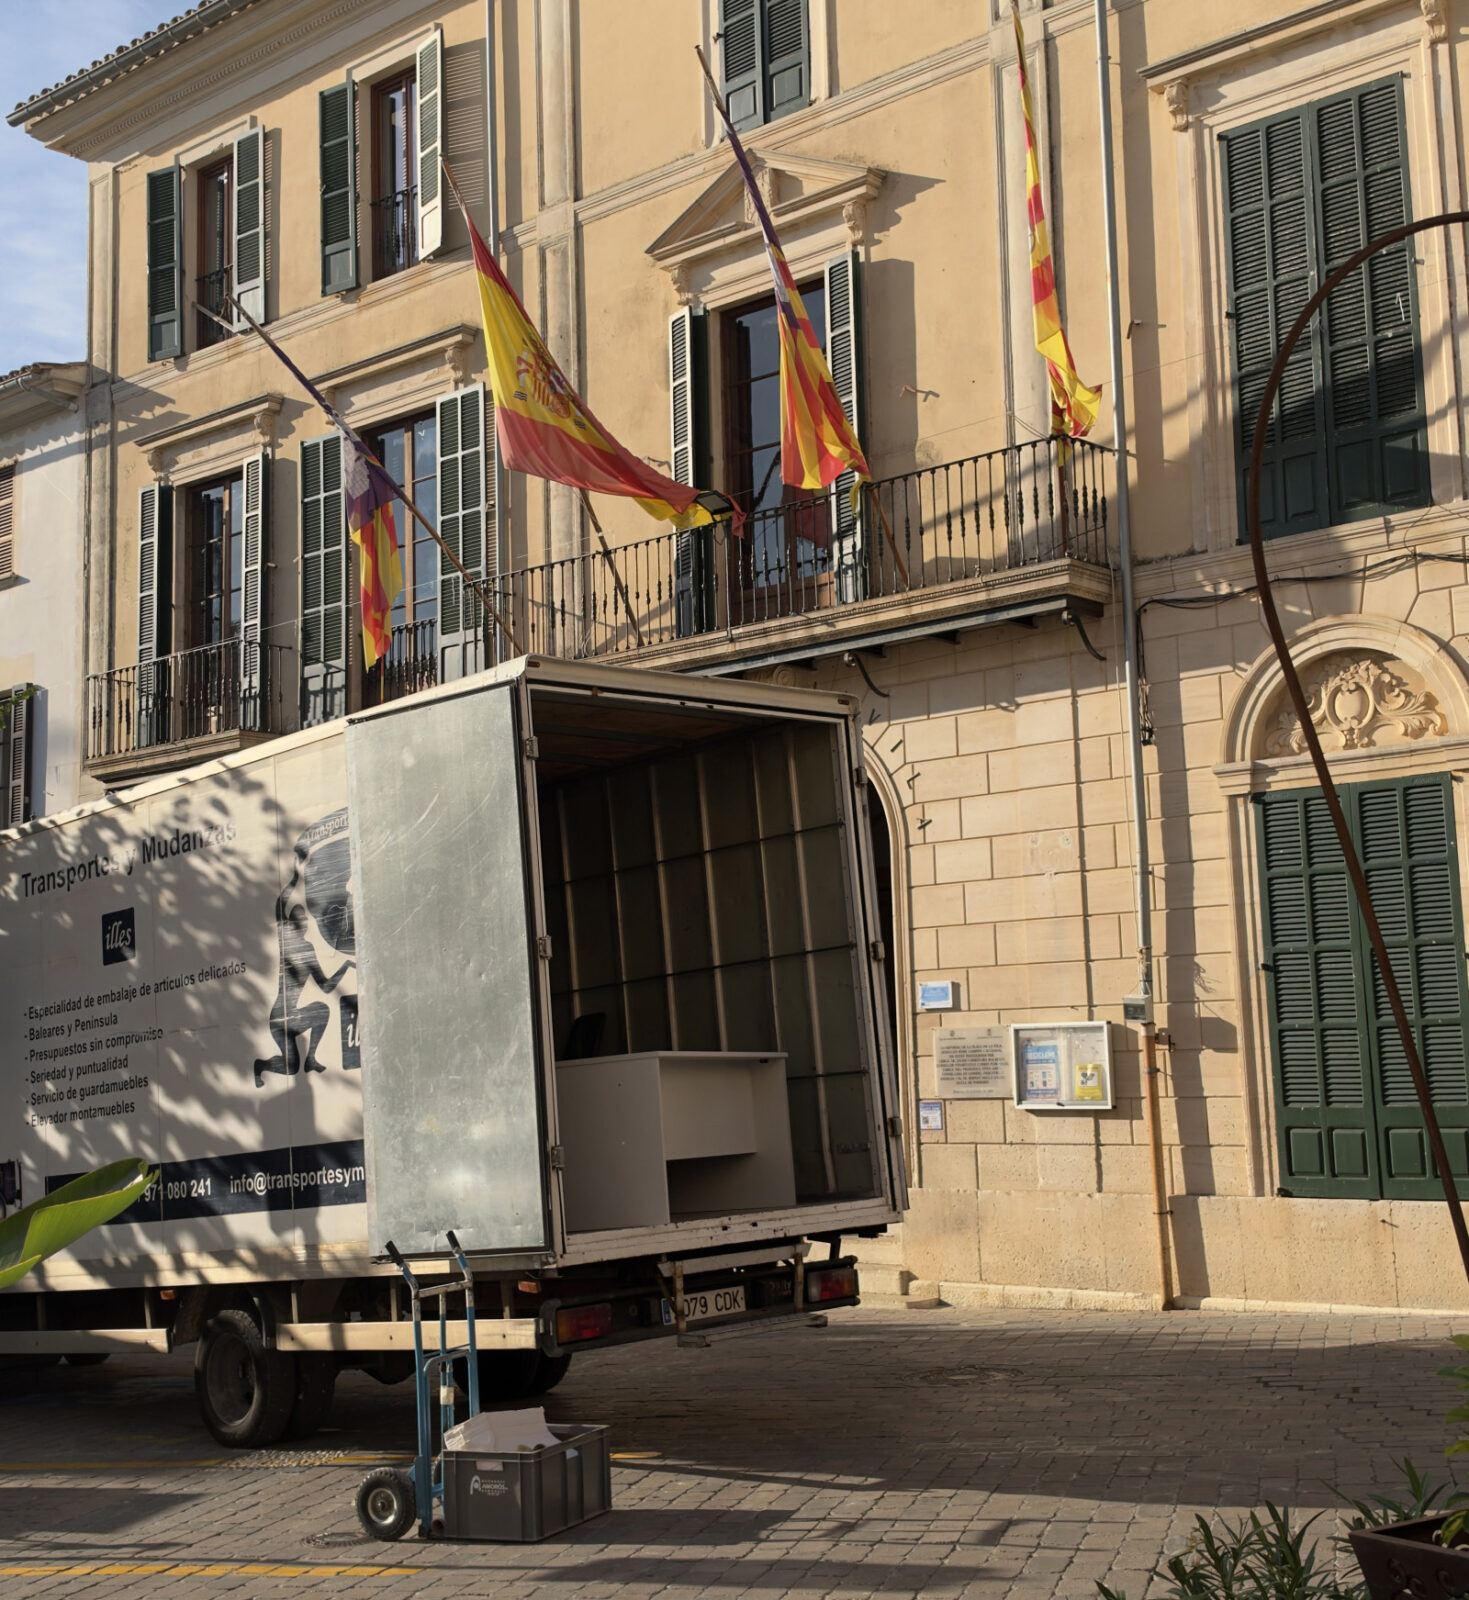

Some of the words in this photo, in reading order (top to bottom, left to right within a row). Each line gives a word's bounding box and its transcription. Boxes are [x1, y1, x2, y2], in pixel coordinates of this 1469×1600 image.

[22, 853, 119, 897] Transportes
[127, 848, 136, 876] y
[142, 823, 236, 865] Mudanzas
[105, 920, 132, 950] illes
[28, 996, 82, 1020] Especialidad
[84, 994, 94, 1009] de
[97, 985, 137, 1006] embalaje
[140, 982, 151, 997] de
[198, 961, 246, 983] delicados
[29, 1024, 64, 1041] Baleares
[67, 1023, 72, 1037] y
[30, 1041, 87, 1062] Presupuestos
[90, 1037, 103, 1052] sin
[105, 1026, 163, 1049] compromiso
[30, 1065, 66, 1084] Seriedad
[69, 1067, 74, 1080] y
[76, 1055, 128, 1079] puntualidad
[31, 1088, 64, 1106] Servicio
[67, 1086, 77, 1100] de
[79, 1075, 149, 1102] guardamuebles
[32, 1110, 67, 1128] Elevador
[70, 1101, 135, 1122] montamuebles
[144, 1183, 163, 1202] 971
[167, 1181, 187, 1199] 080
[190, 1178, 211, 1198] 241
[229, 1166, 365, 1196] info@transportesym
[681, 1295, 708, 1318] 079
[714, 1289, 741, 1312] CDK
